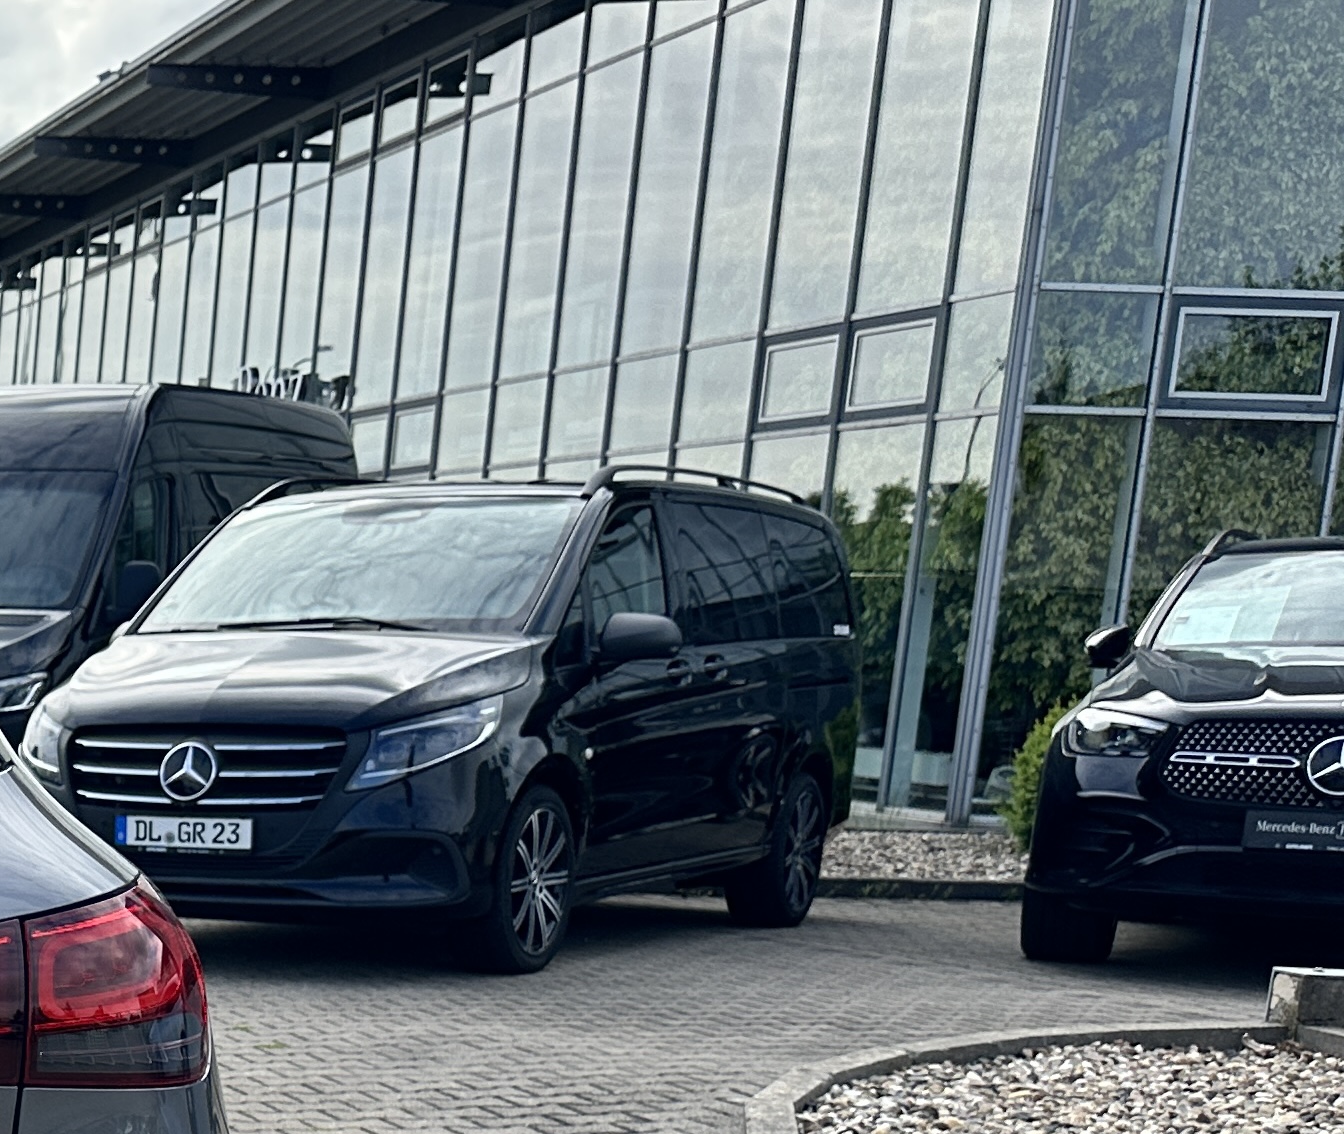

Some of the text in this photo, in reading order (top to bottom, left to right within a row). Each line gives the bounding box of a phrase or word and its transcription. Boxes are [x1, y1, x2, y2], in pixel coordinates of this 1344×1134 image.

[134, 819, 241, 844] DL GR 23
